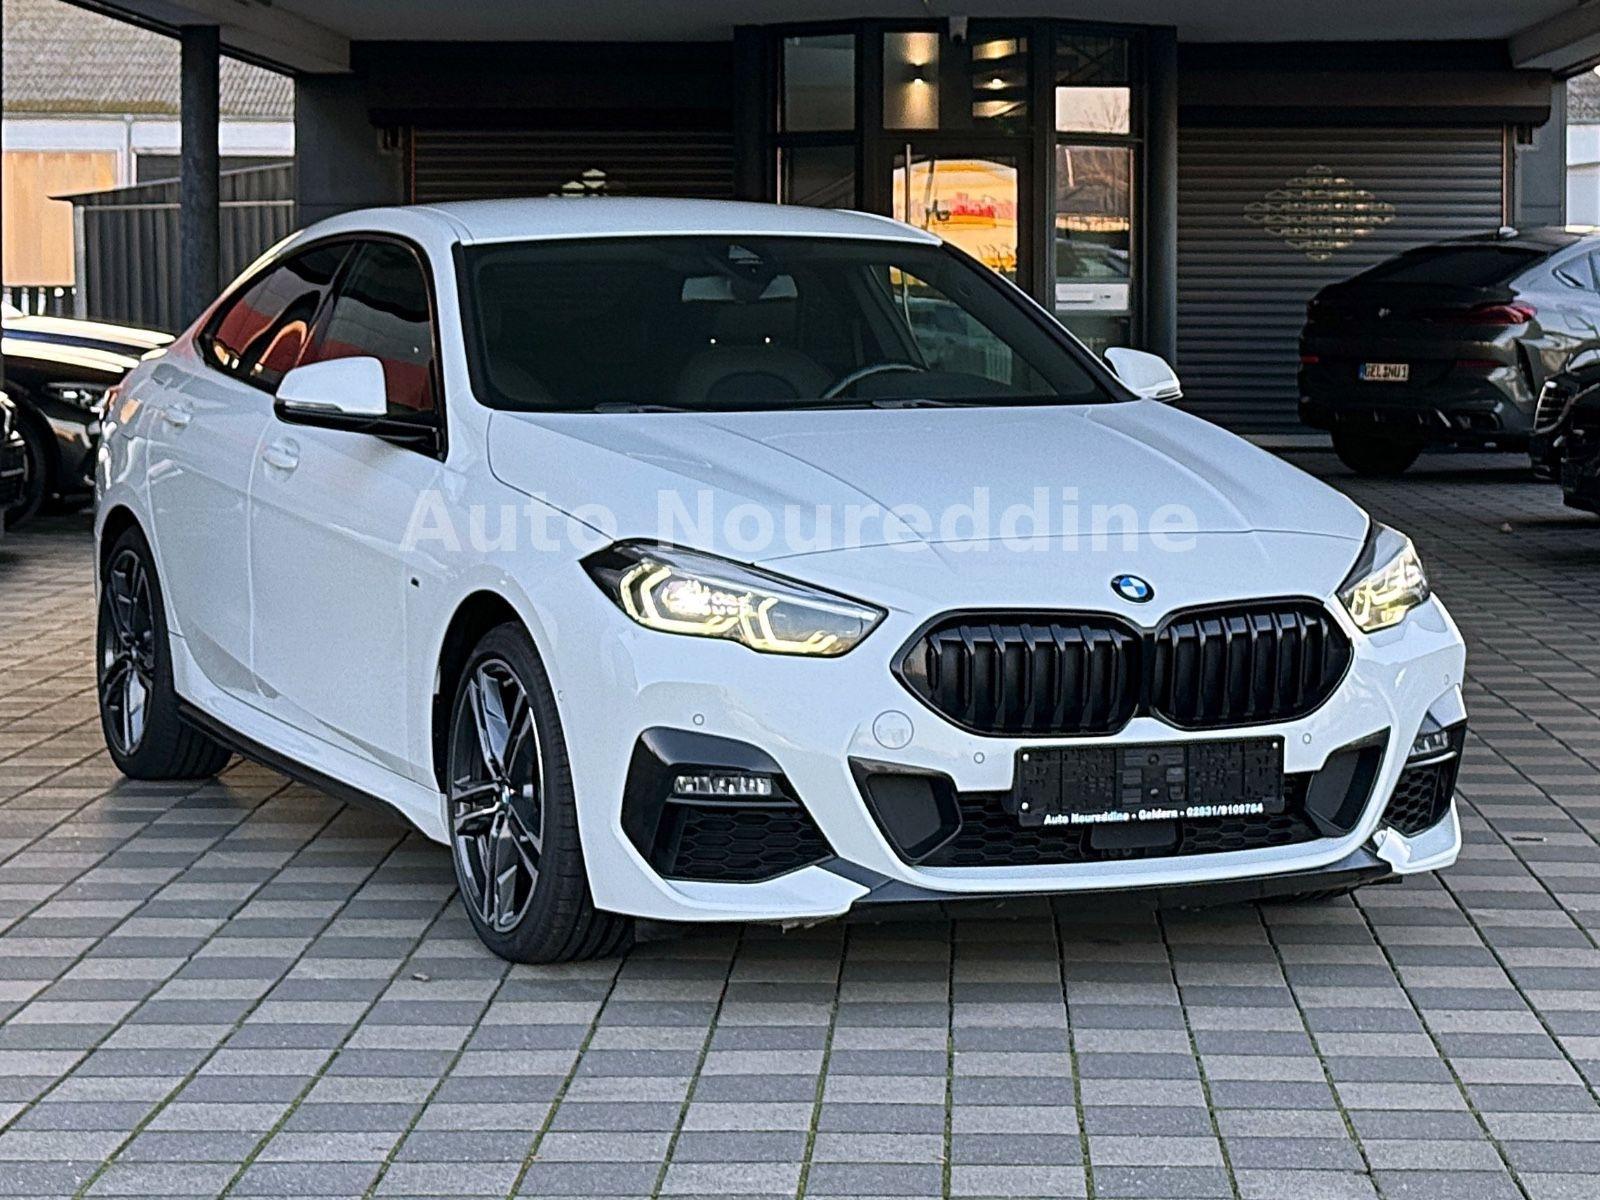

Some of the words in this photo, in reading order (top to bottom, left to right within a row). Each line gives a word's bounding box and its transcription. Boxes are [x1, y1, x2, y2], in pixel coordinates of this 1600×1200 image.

[1044, 813, 1069, 825] Auto
[1071, 811, 1129, 824] Noureddine
[1138, 808, 1178, 820] Geldern
